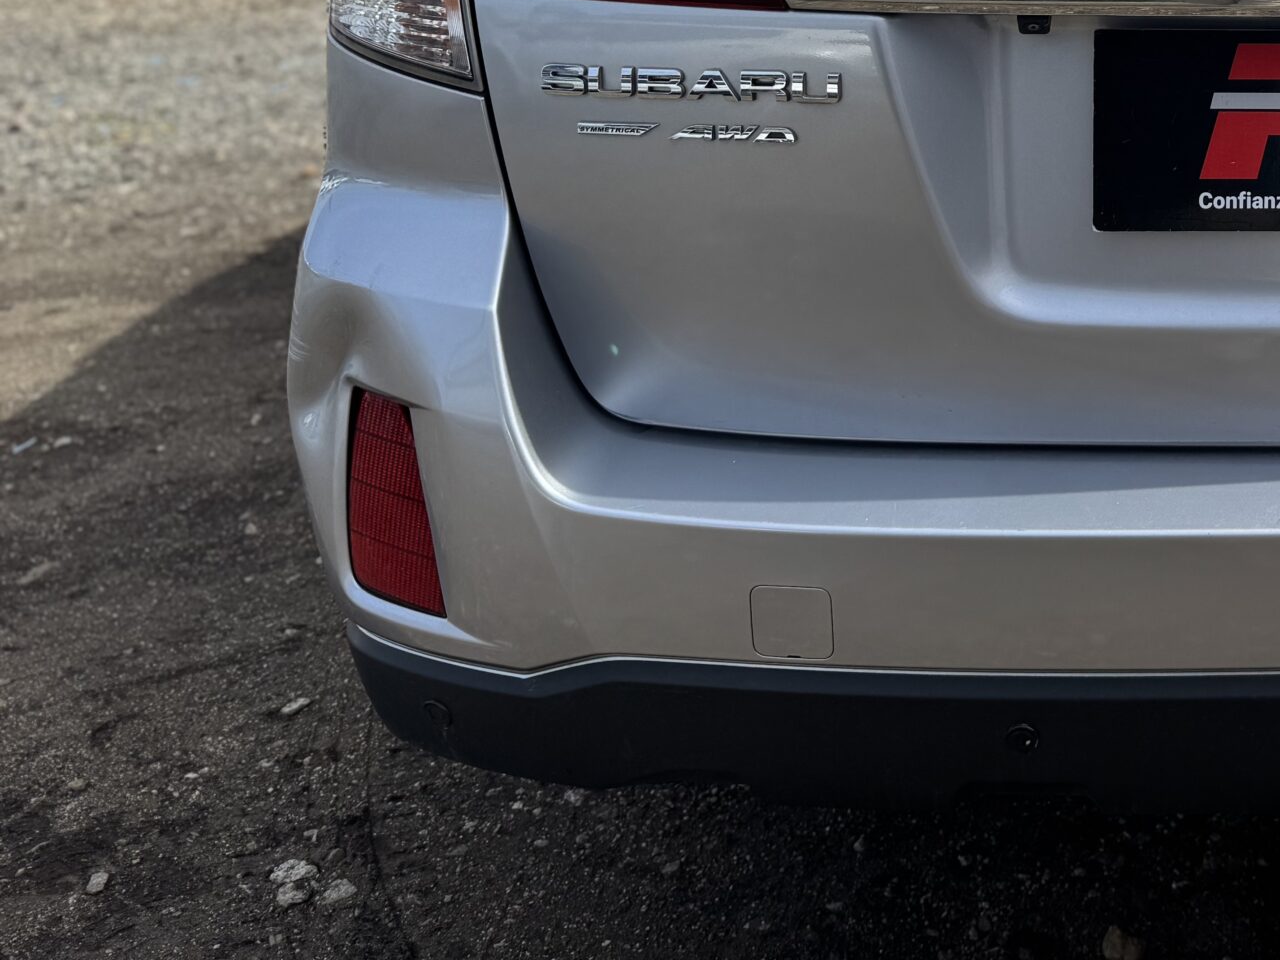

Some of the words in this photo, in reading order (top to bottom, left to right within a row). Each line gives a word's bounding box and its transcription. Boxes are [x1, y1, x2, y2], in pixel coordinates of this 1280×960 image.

[541, 63, 843, 104] SUBARU
[579, 126, 642, 134] SYMMETRICAL
[667, 123, 798, 144] AWD
